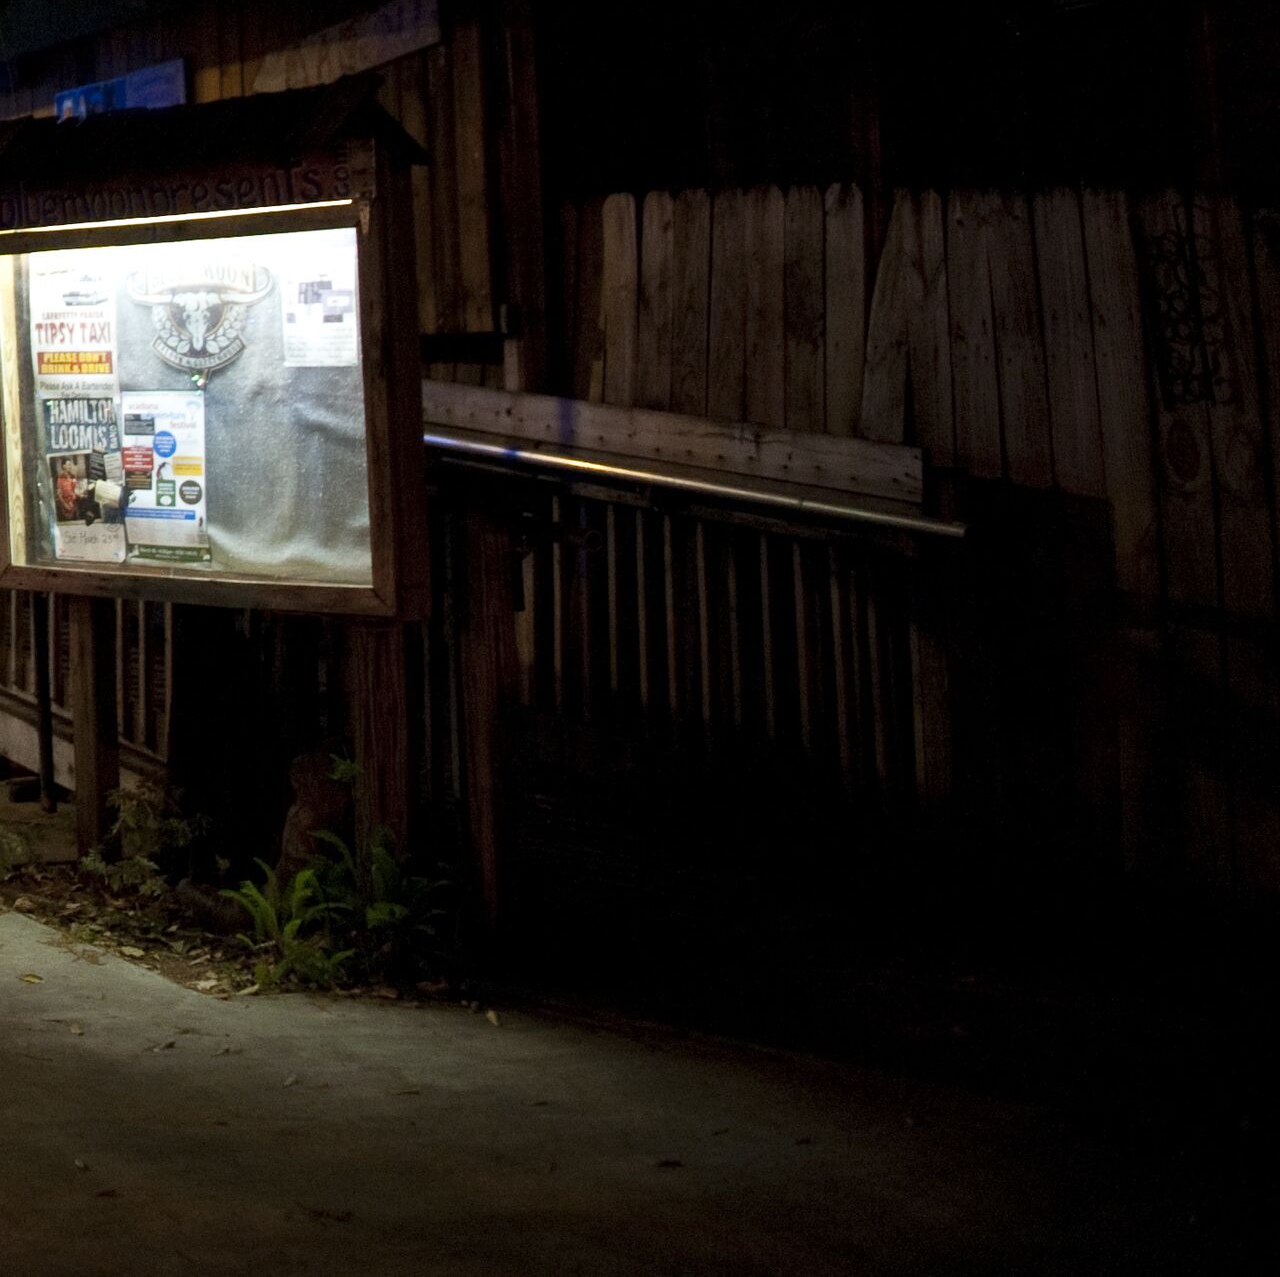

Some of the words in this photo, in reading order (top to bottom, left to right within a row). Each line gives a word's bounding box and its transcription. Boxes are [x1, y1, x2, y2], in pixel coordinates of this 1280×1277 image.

[34, 322, 75, 344] TIPSY
[79, 322, 112, 344] TAXI
[43, 352, 78, 363] PLEASE
[50, 399, 116, 424] HAMILTON
[50, 424, 108, 450] LOOMIS
